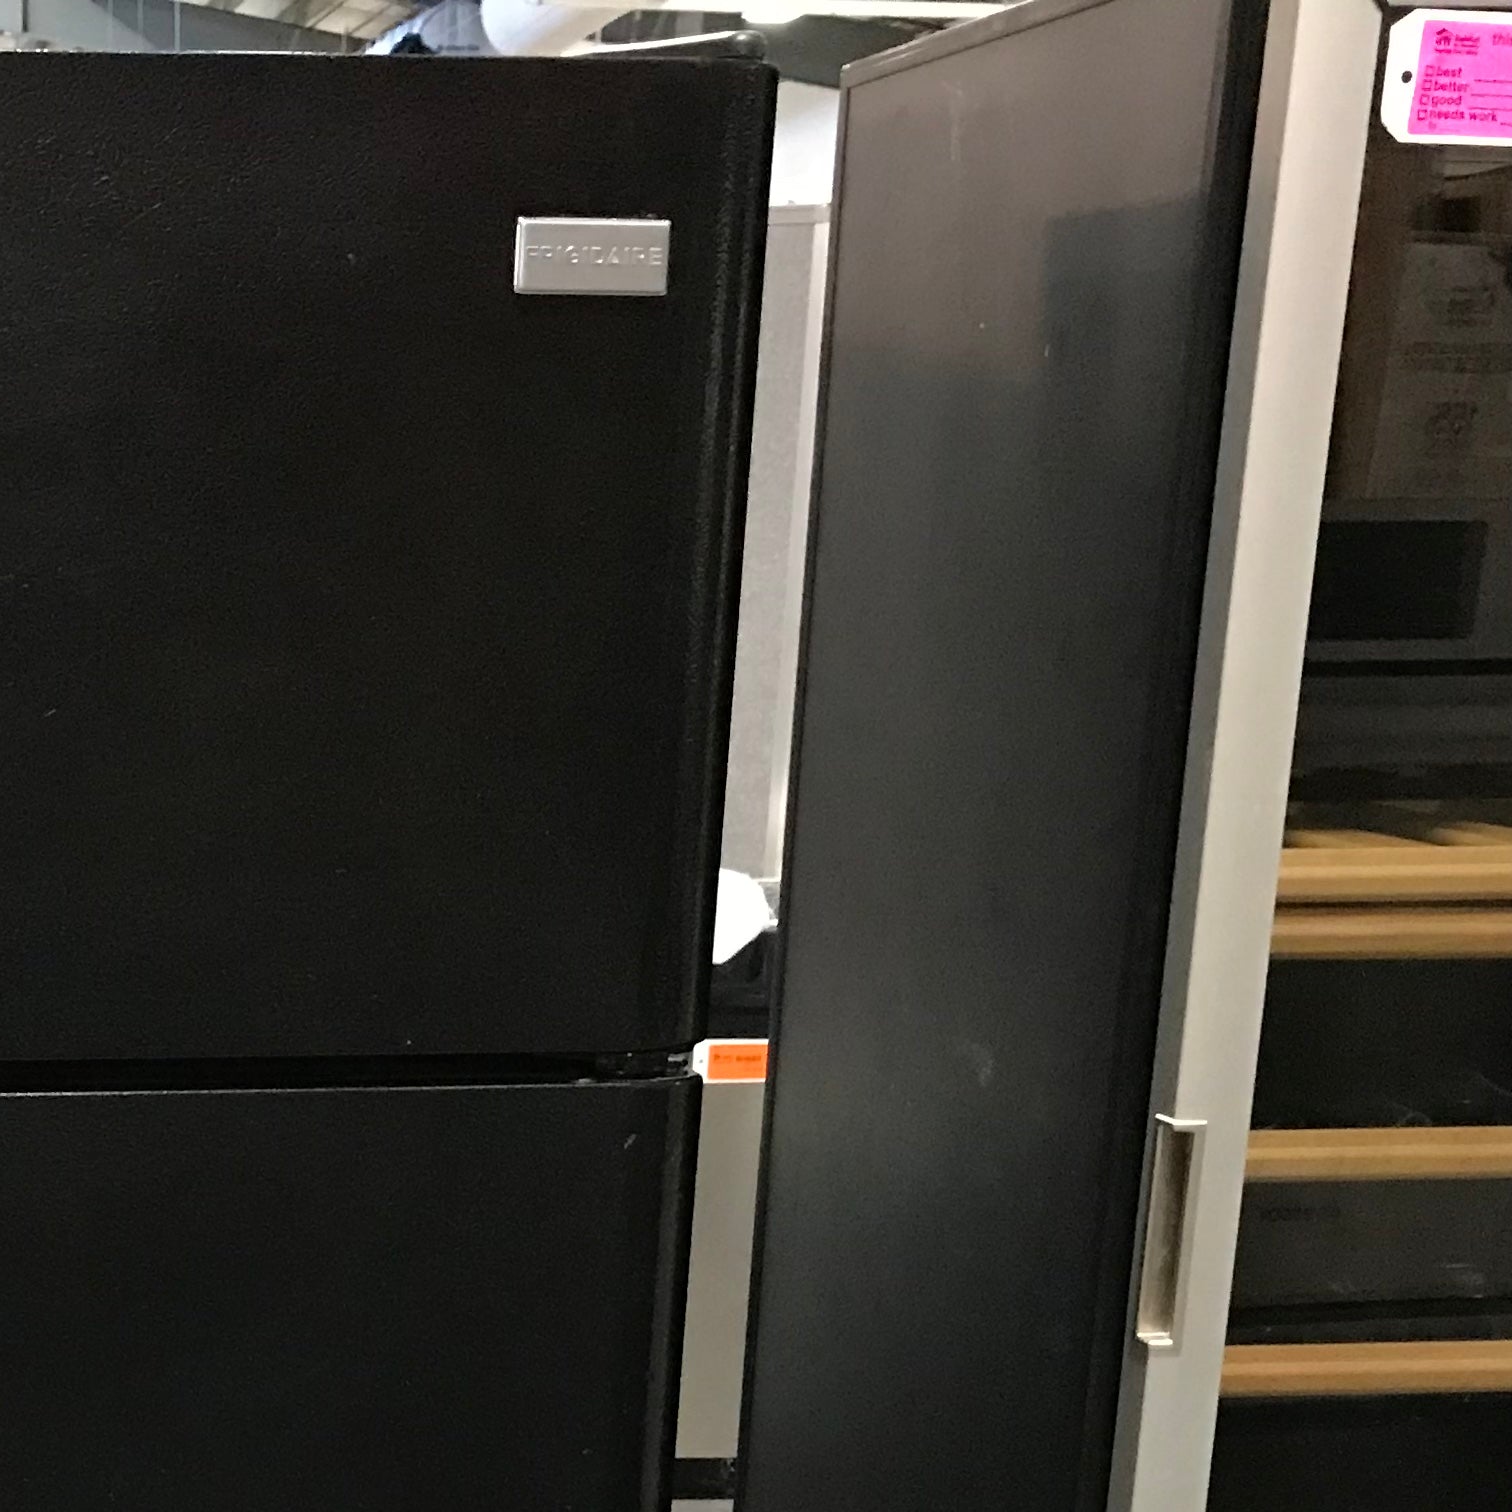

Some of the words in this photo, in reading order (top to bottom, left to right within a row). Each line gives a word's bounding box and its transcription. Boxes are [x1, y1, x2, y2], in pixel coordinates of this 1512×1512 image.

[1436, 66, 1463, 77] best
[1434, 81, 1469, 92] better
[1431, 96, 1462, 107] good
[1429, 110, 1465, 120] needs
[1469, 112, 1498, 122] work
[525, 245, 663, 265] FRIGIDAIRE
